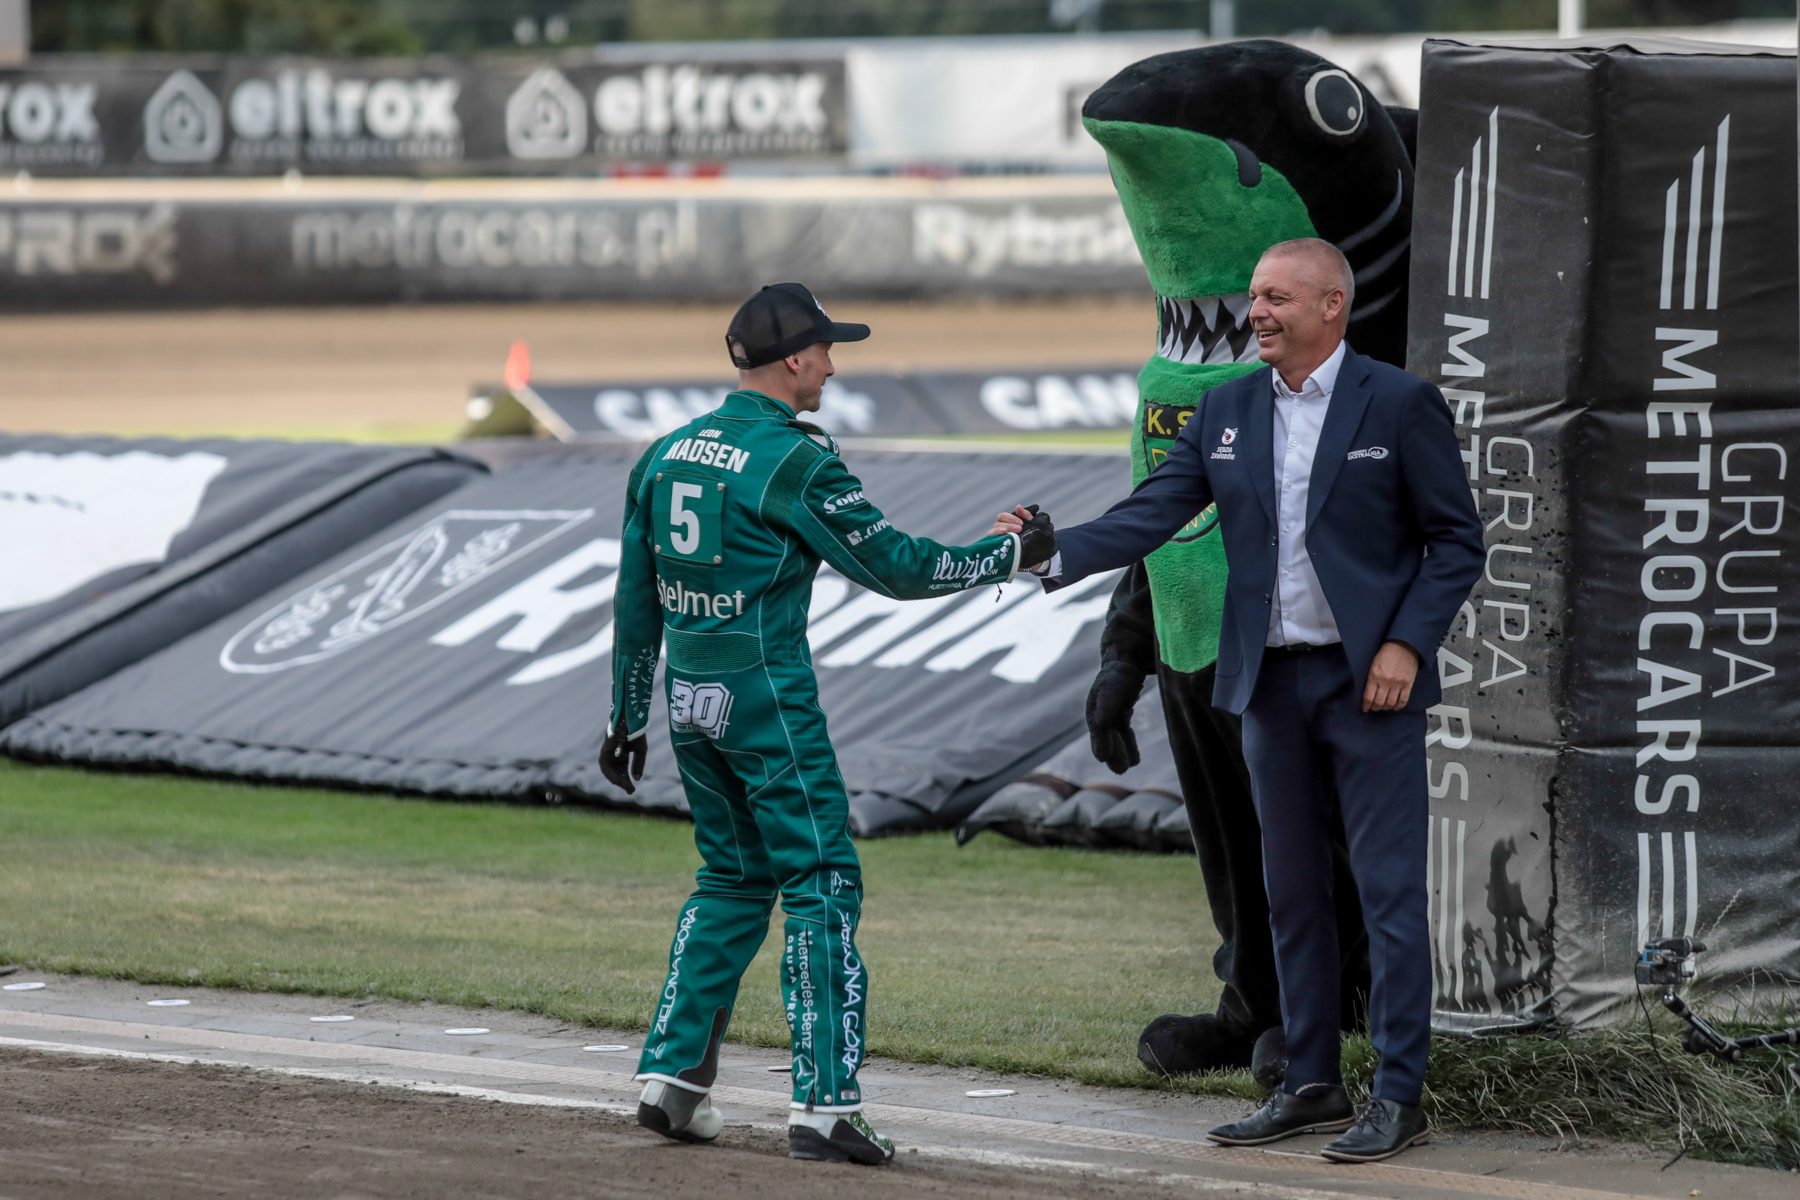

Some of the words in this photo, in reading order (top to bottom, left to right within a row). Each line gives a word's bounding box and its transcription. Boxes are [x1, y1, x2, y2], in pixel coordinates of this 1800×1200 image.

[230, 70, 459, 140] eltrox
[594, 65, 828, 134] eltrox
[662, 438, 750, 473] MADSEN
[698, 429, 722, 438] LEON
[670, 481, 703, 555] 5
[656, 573, 746, 619] Stelmet
[1480, 436, 1534, 689] GRUPA
[1635, 327, 1719, 815] METROCARS
[1711, 442, 1788, 698] GRUPA
[670, 677, 730, 739] 30
[786, 935, 797, 984] GRUPA
[797, 930, 818, 1049] Mercedes-Benz
[653, 957, 682, 1035] ZIELONA
